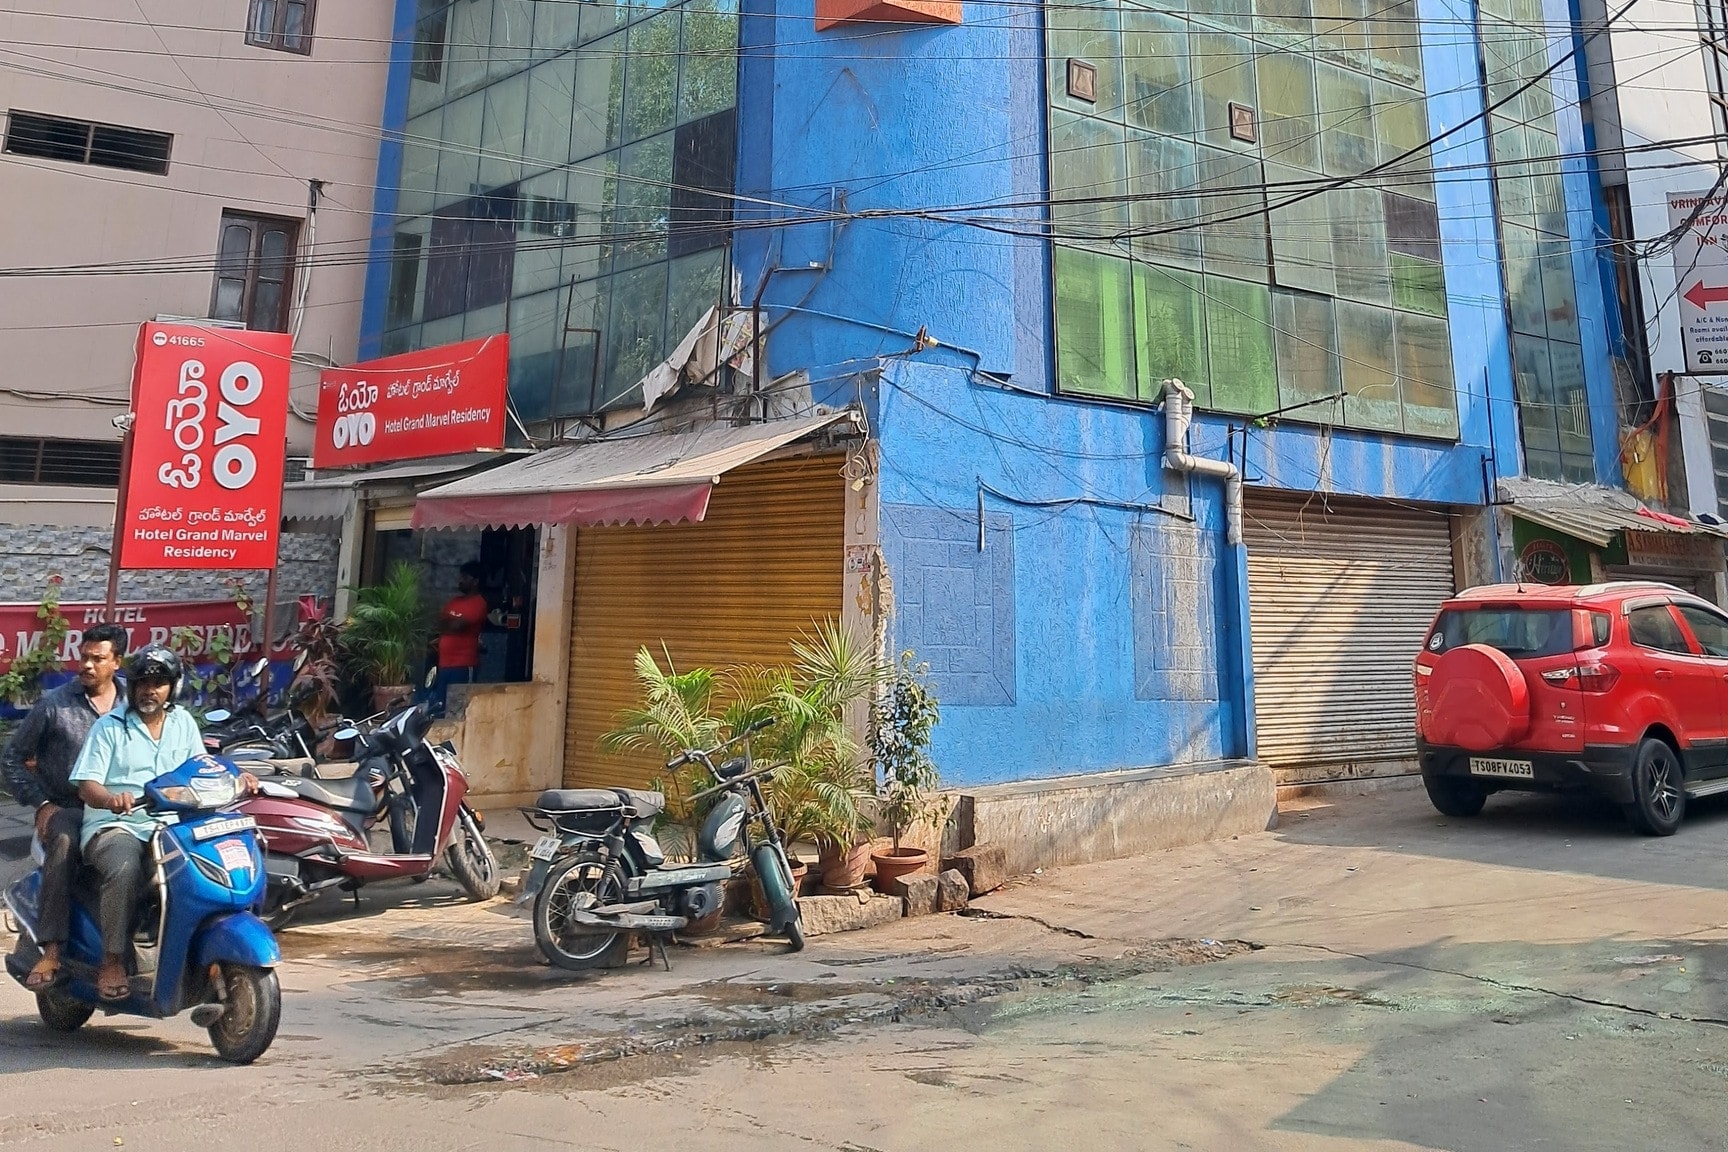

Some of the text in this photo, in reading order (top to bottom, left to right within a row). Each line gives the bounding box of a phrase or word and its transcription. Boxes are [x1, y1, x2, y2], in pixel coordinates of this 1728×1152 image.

[169, 334, 205, 347] 41665
[338, 380, 378, 413] ఓయో
[158, 359, 208, 489] ఓయో
[212, 360, 264, 490] OYO
[333, 411, 376, 449] OYO
[384, 407, 491, 434] Hotel Grand Marvel Residency
[139, 506, 183, 521] హోటల్
[187, 507, 221, 526] గ్రాండ్
[134, 528, 268, 541] Hotel Grand Marvel
[163, 545, 237, 560] Residency
